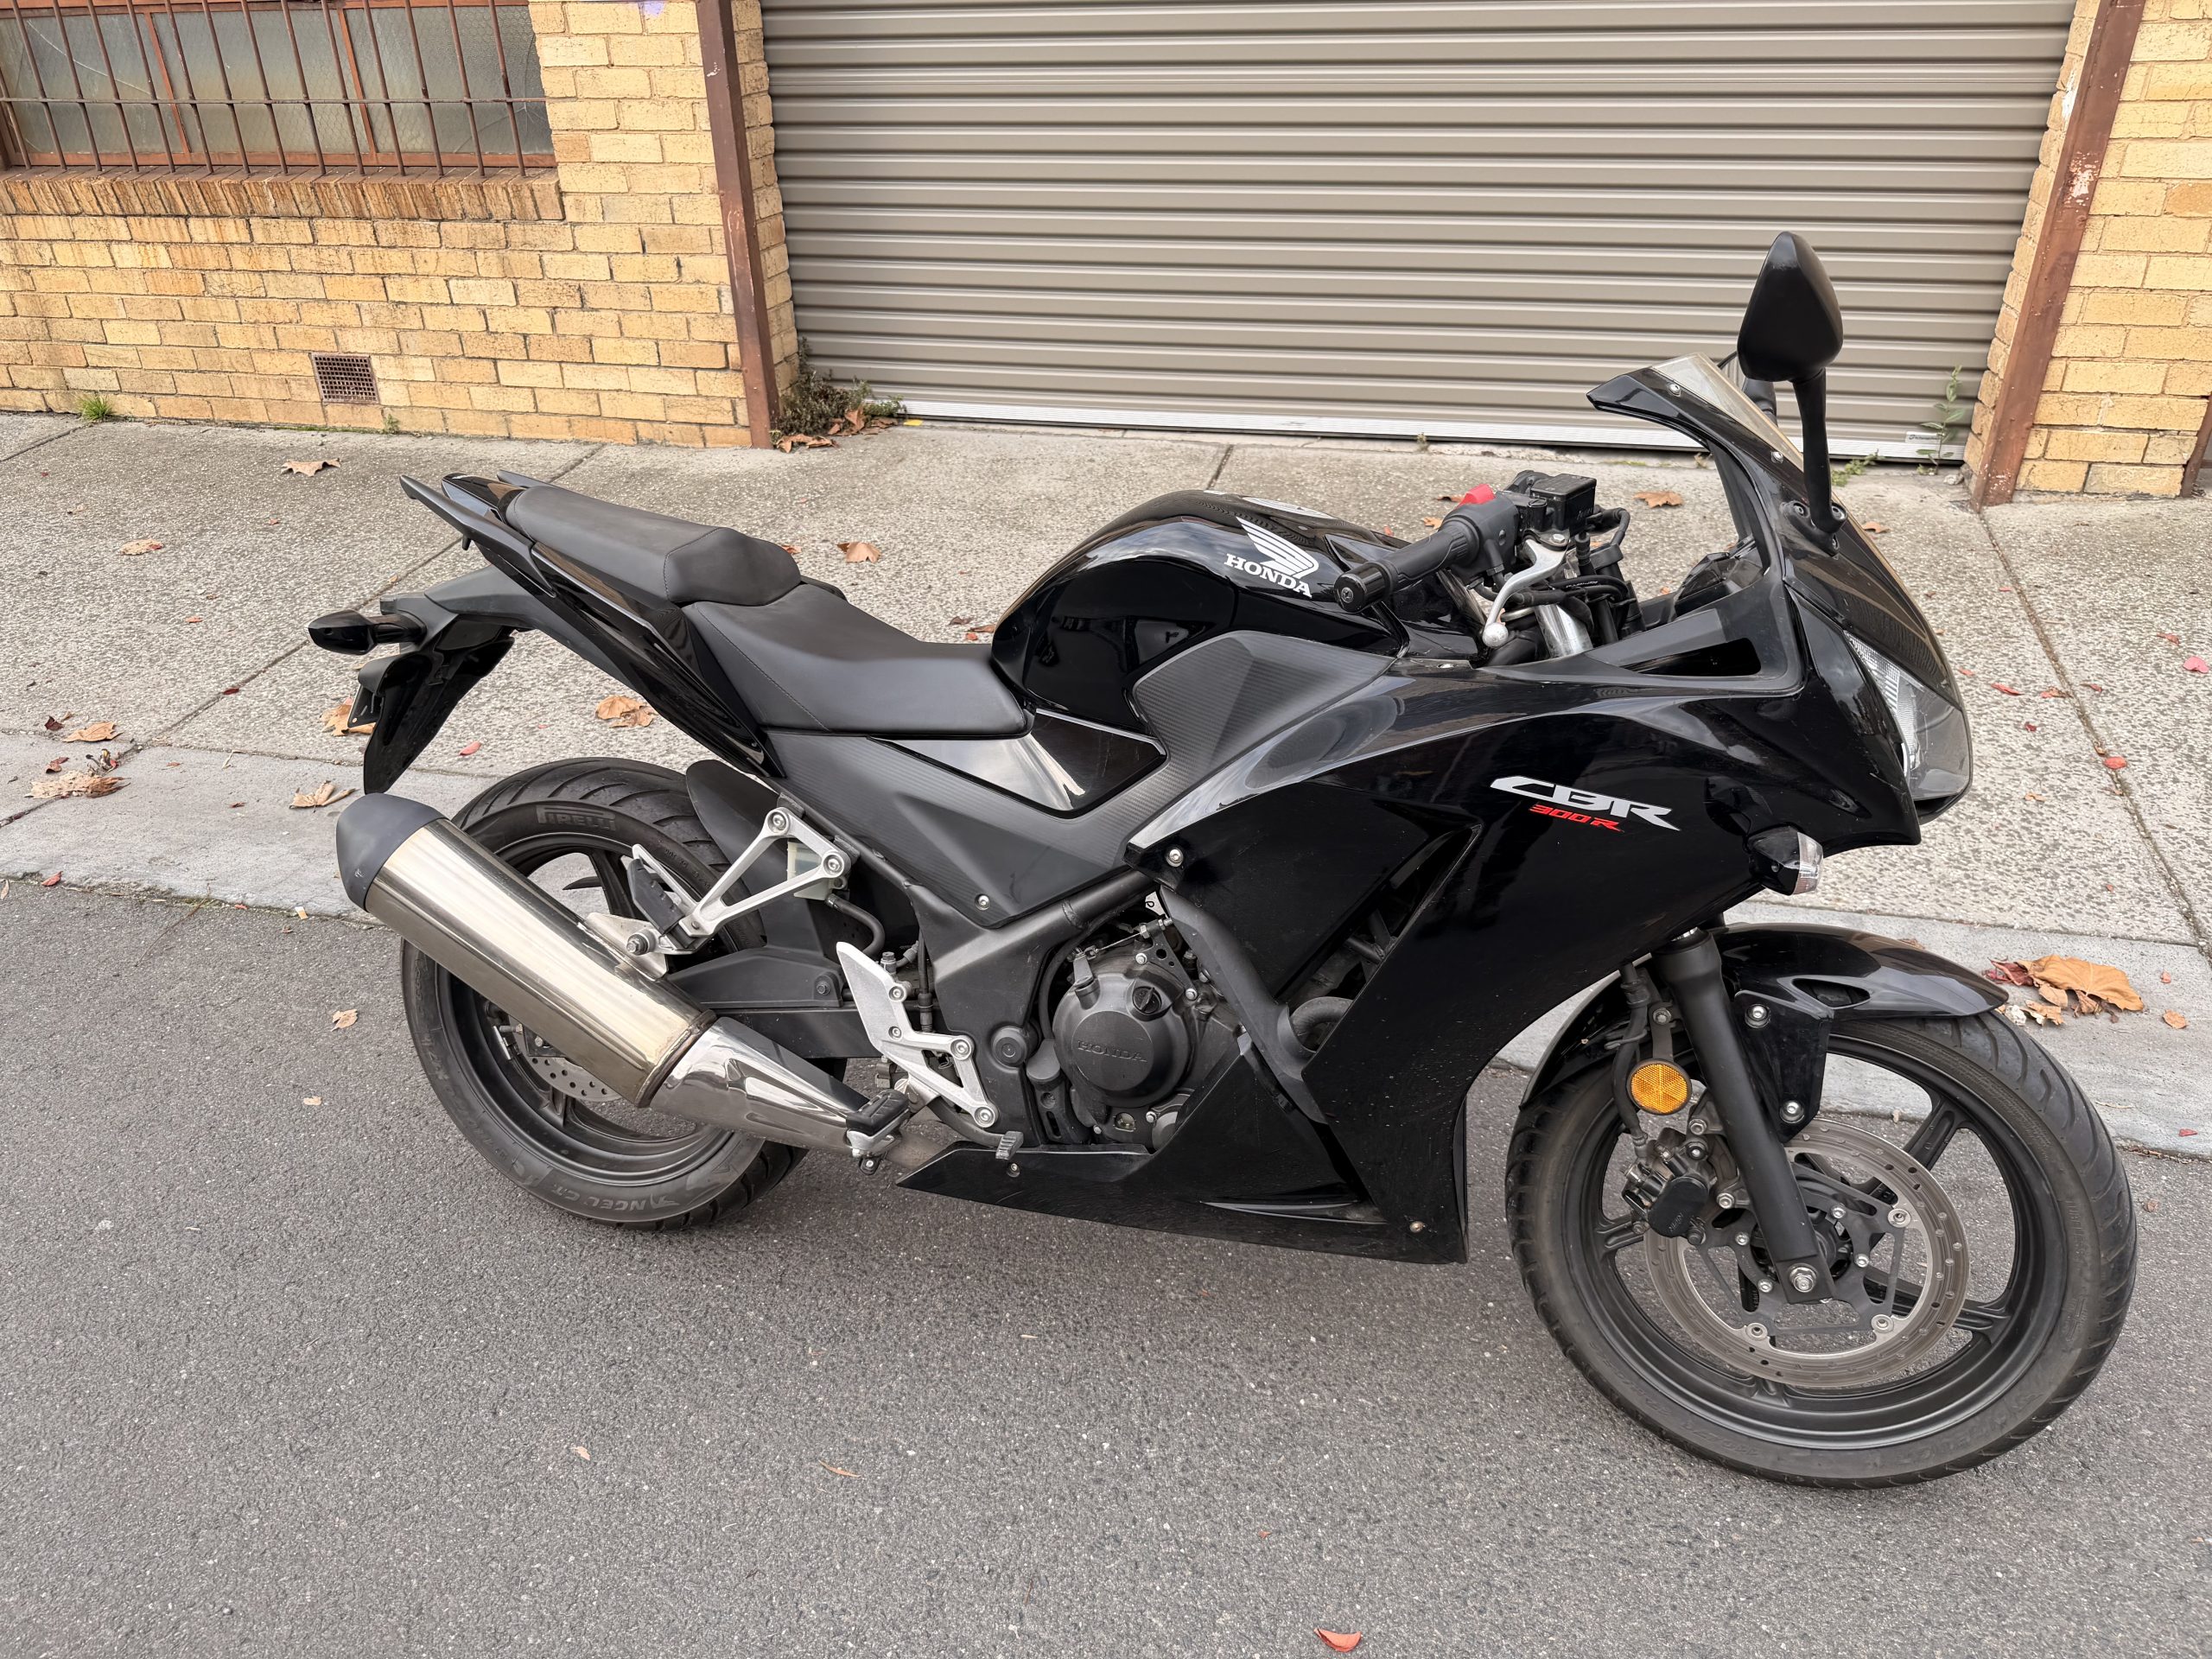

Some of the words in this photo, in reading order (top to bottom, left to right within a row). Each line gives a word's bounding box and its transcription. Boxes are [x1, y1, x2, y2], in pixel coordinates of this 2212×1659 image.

[1224, 553, 1313, 599] HONDA
[536, 804, 617, 831] PIRELLI
[1490, 775, 1681, 831] CBR
[1529, 803, 1624, 833] 300R
[1077, 1040, 1147, 1064] HONDA
